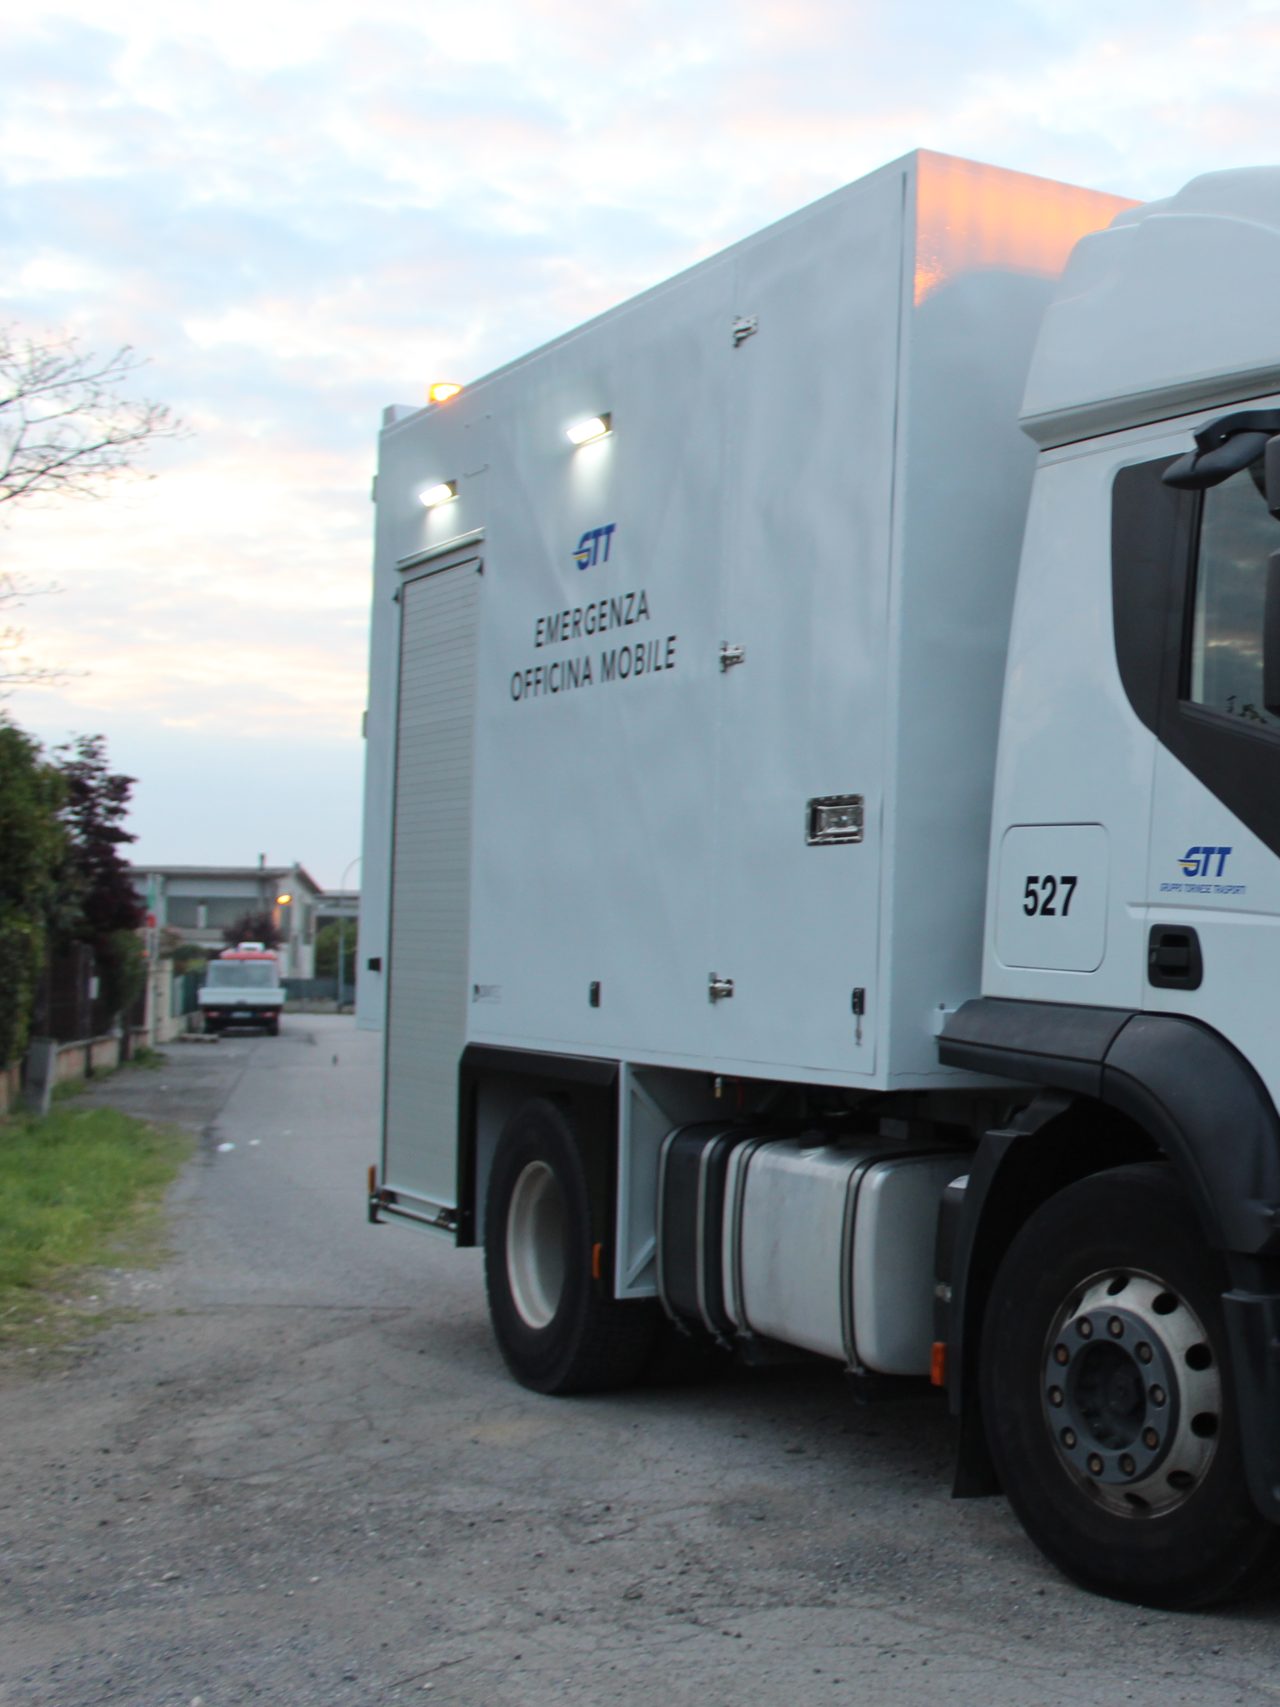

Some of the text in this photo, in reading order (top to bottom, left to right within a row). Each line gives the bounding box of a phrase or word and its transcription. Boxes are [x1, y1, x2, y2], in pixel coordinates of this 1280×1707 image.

[571, 522, 617, 571] GTT
[534, 589, 650, 648] EMERGENZA
[510, 634, 676, 701] OFFICINA MOBILE
[1177, 845, 1233, 877] GTT
[1023, 874, 1078, 917] 527
